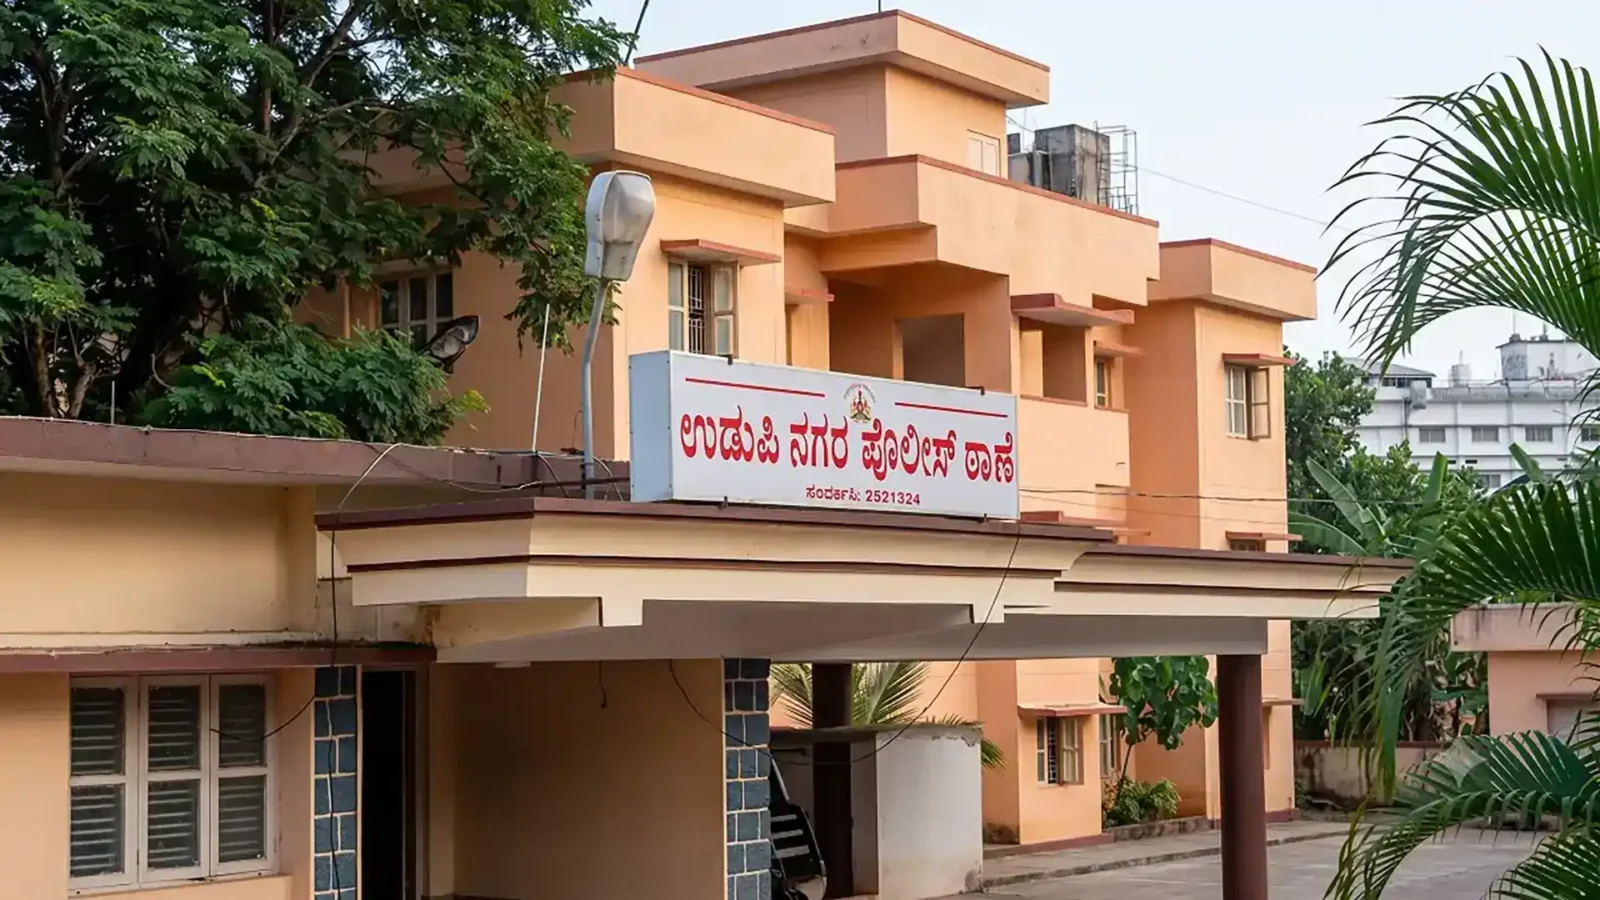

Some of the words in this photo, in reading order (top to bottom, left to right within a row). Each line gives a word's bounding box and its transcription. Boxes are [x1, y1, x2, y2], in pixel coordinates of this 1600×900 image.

[680, 405, 780, 464] ಉಡುಪಿ
[790, 411, 849, 469] ನಗರ
[861, 418, 957, 482] ಪೊಲೀಸ್
[964, 431, 1014, 484] ಠಾಣೆ
[865, 489, 921, 506] 2521324
